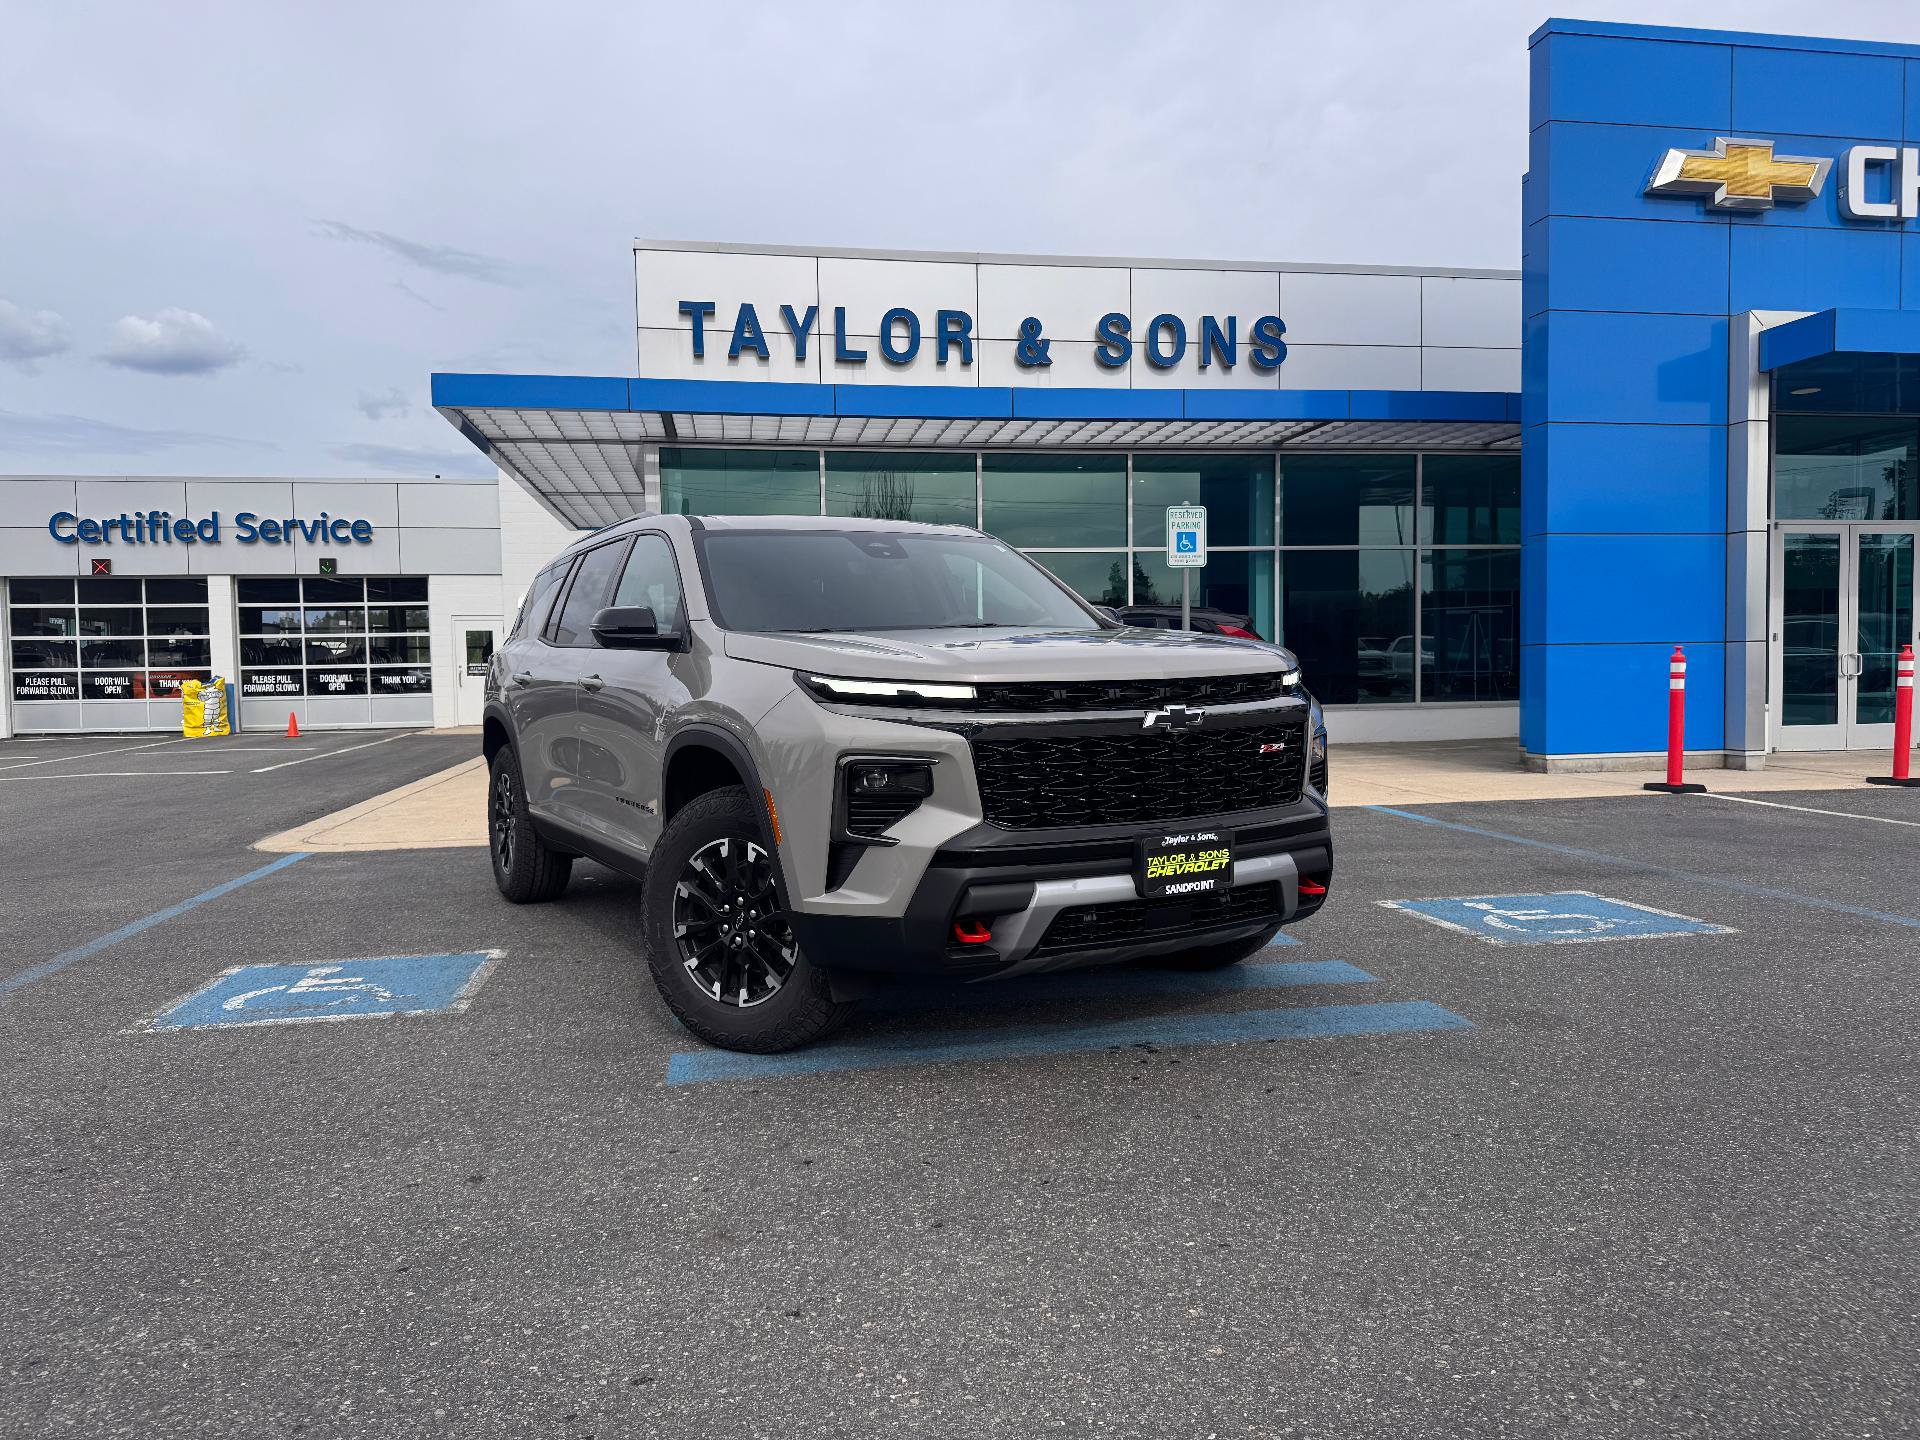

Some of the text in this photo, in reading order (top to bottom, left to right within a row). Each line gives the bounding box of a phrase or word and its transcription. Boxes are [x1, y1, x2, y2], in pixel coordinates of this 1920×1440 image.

[679, 301, 1289, 369] TAYLOR & SONS
[1170, 511, 1203, 519] RESERVED
[49, 511, 373, 544] Certified Service
[1171, 521, 1201, 530] PARKING
[25, 677, 67, 686] PLEASE PULL
[94, 677, 130, 686] DOOR WILL
[252, 675, 292, 684] PLEASE PULL
[319, 674, 353, 683] DOOR WILL
[381, 675, 417, 684] THANK YOU!
[159, 679, 180, 688] THANK
[243, 683, 300, 693] FORWARD SLOWLY
[328, 682, 346, 691] OPEN
[16, 686, 76, 695] FORWARD SLOWLY
[104, 686, 122, 694] OPEN
[1163, 834, 1190, 846] Taylor
[1196, 832, 1216, 841] Sons
[1147, 848, 1230, 867] TAYLOR & SONS
[1147, 858, 1230, 878] CHEVROLET
[1165, 879, 1215, 895] SANDPOINT
